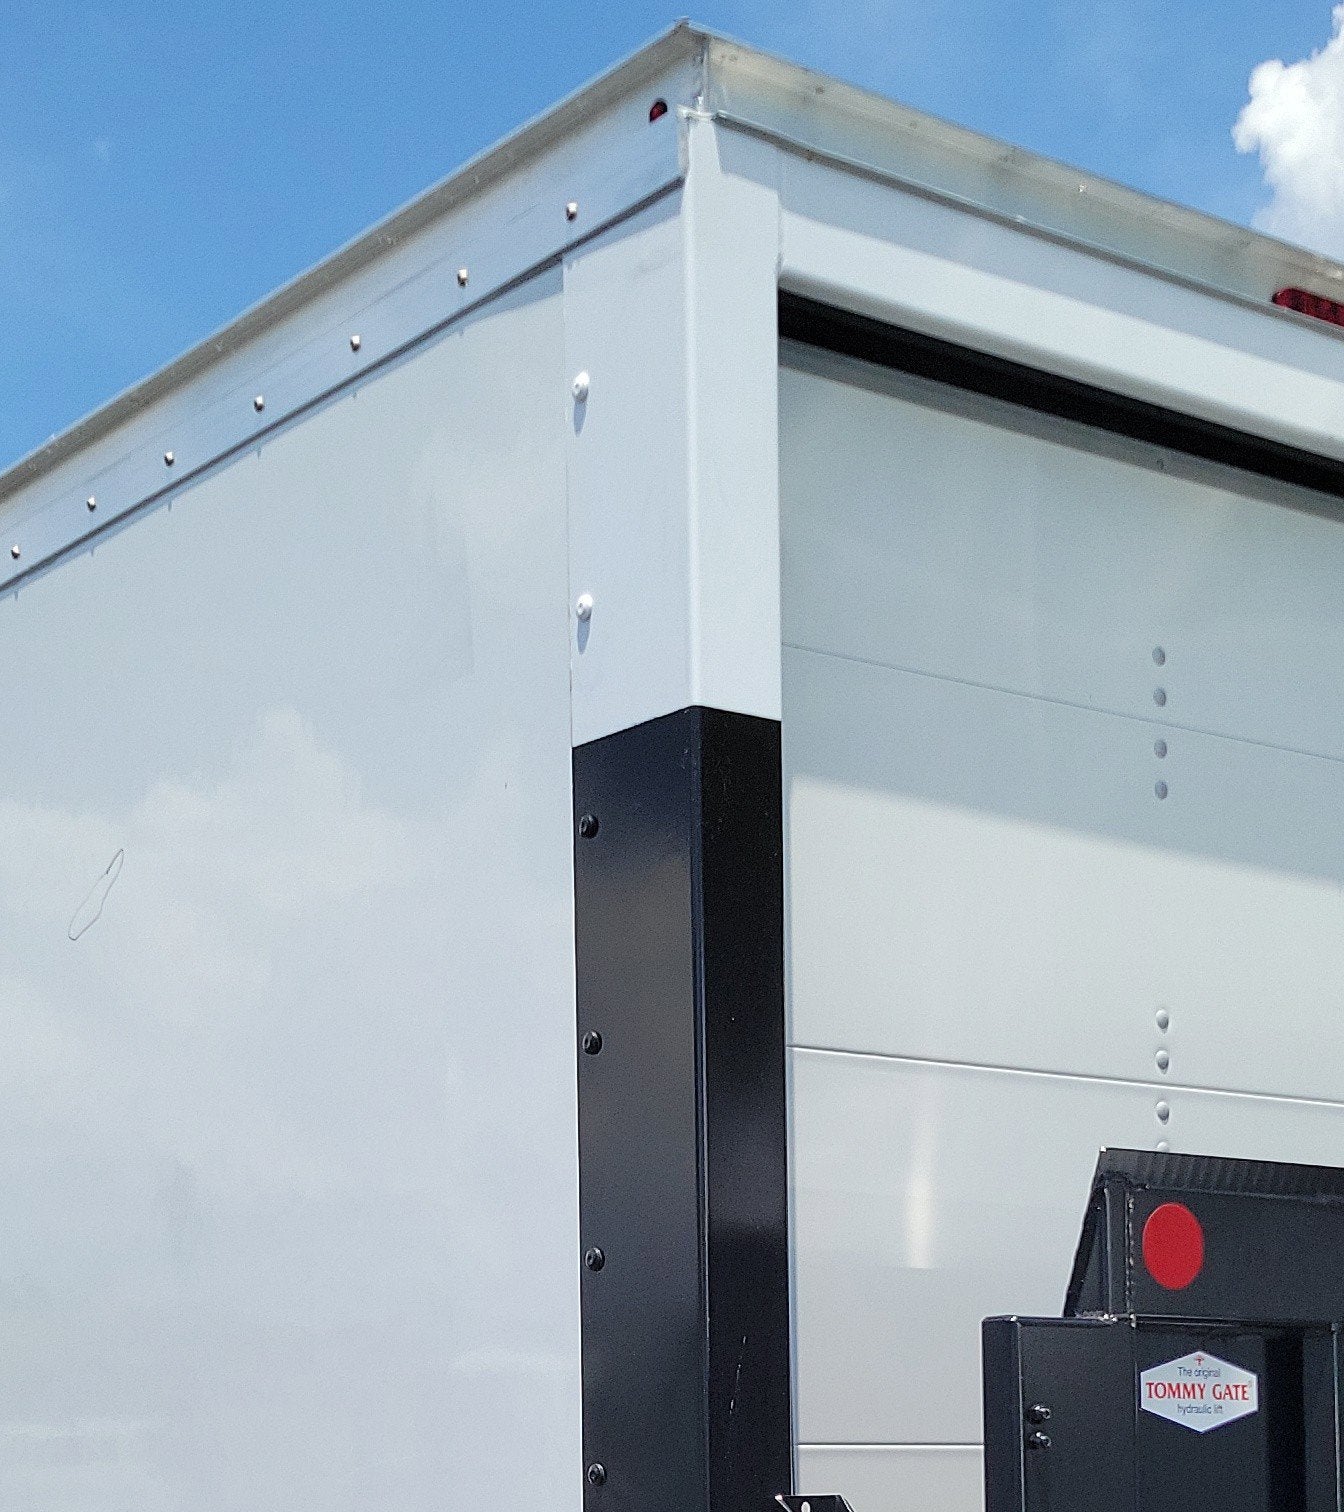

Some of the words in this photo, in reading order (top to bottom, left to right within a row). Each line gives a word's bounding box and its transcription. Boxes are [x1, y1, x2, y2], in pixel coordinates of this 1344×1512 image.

[1177, 1366, 1193, 1377] The
[1145, 1381, 1206, 1400] TOMMY
[1212, 1383, 1250, 1401] GATE
